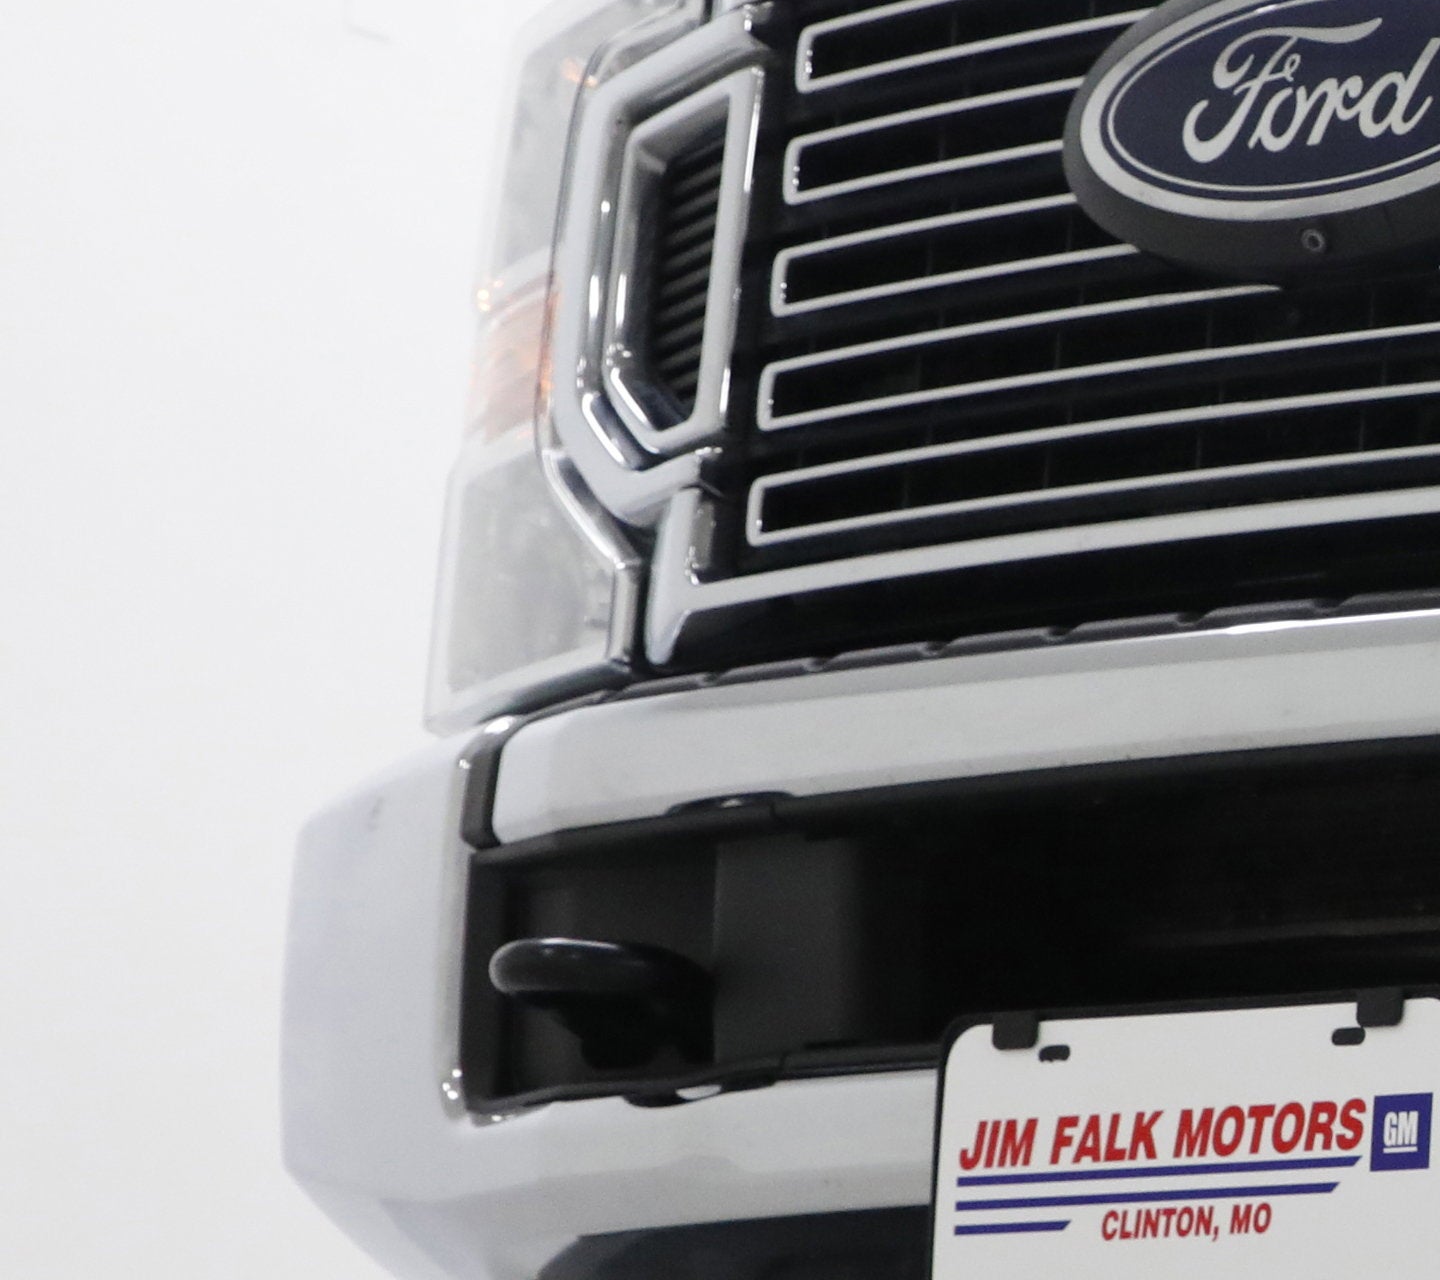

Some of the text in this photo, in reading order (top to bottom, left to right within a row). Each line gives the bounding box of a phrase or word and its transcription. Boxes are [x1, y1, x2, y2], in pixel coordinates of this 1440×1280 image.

[958, 1098, 1368, 1171] JIM FALK MOTORS
[1382, 1109, 1420, 1148] GM
[1101, 1202, 1273, 1243] CLINTON, MO
